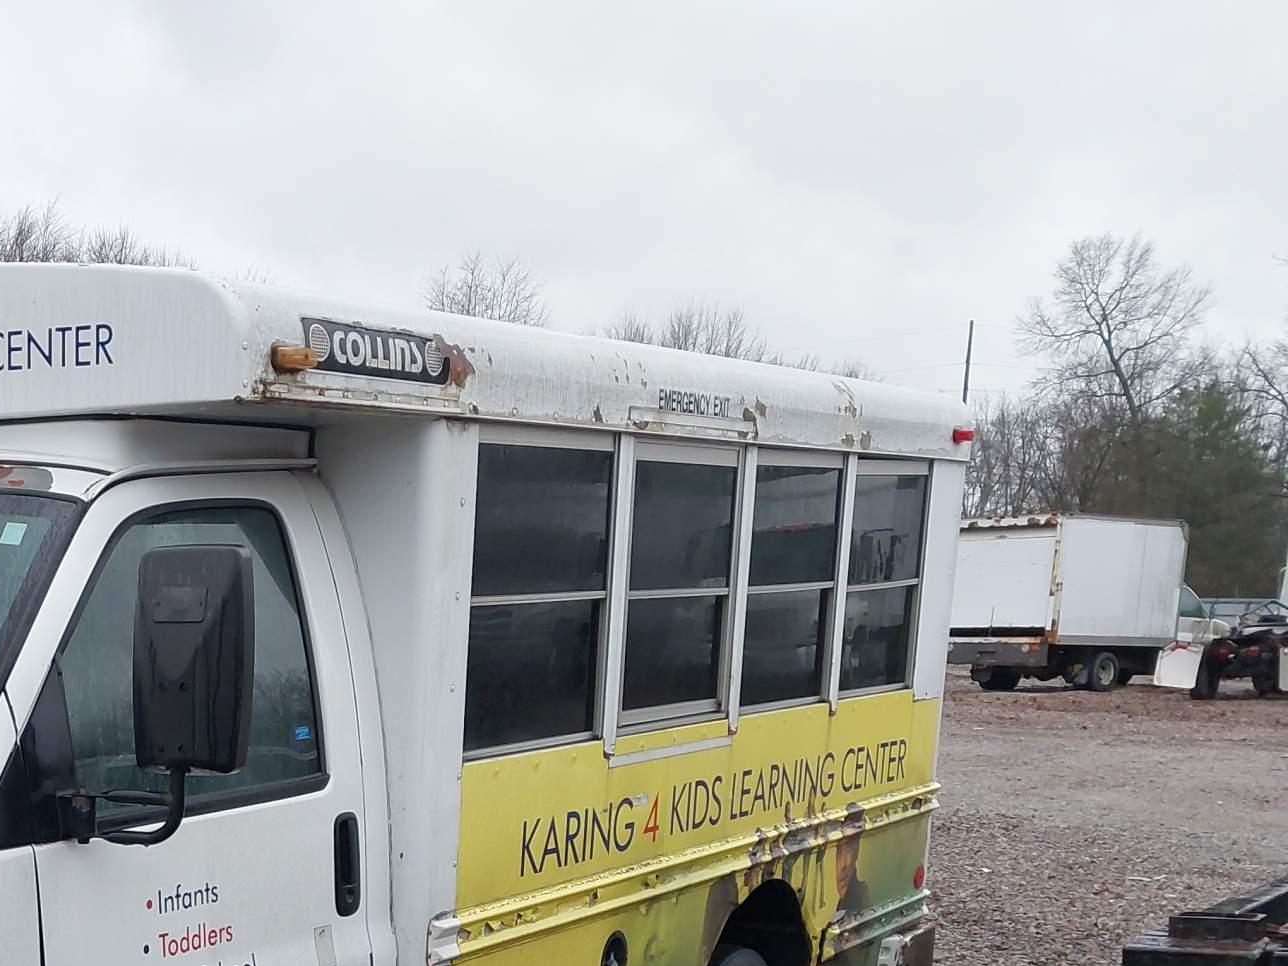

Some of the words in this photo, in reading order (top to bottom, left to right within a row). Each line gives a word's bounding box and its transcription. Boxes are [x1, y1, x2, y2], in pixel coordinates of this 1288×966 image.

[333, 331, 423, 373] COLLINS
[658, 388, 712, 415] EMERGENCY
[713, 396, 731, 418] EXIT
[520, 797, 635, 877] KARING
[643, 791, 660, 843] 4
[669, 775, 723, 836] KIDS
[730, 751, 835, 821] LEARNING
[841, 739, 907, 793] CENTER
[157, 882, 219, 914] Infants
[158, 922, 233, 958] Toddlers
